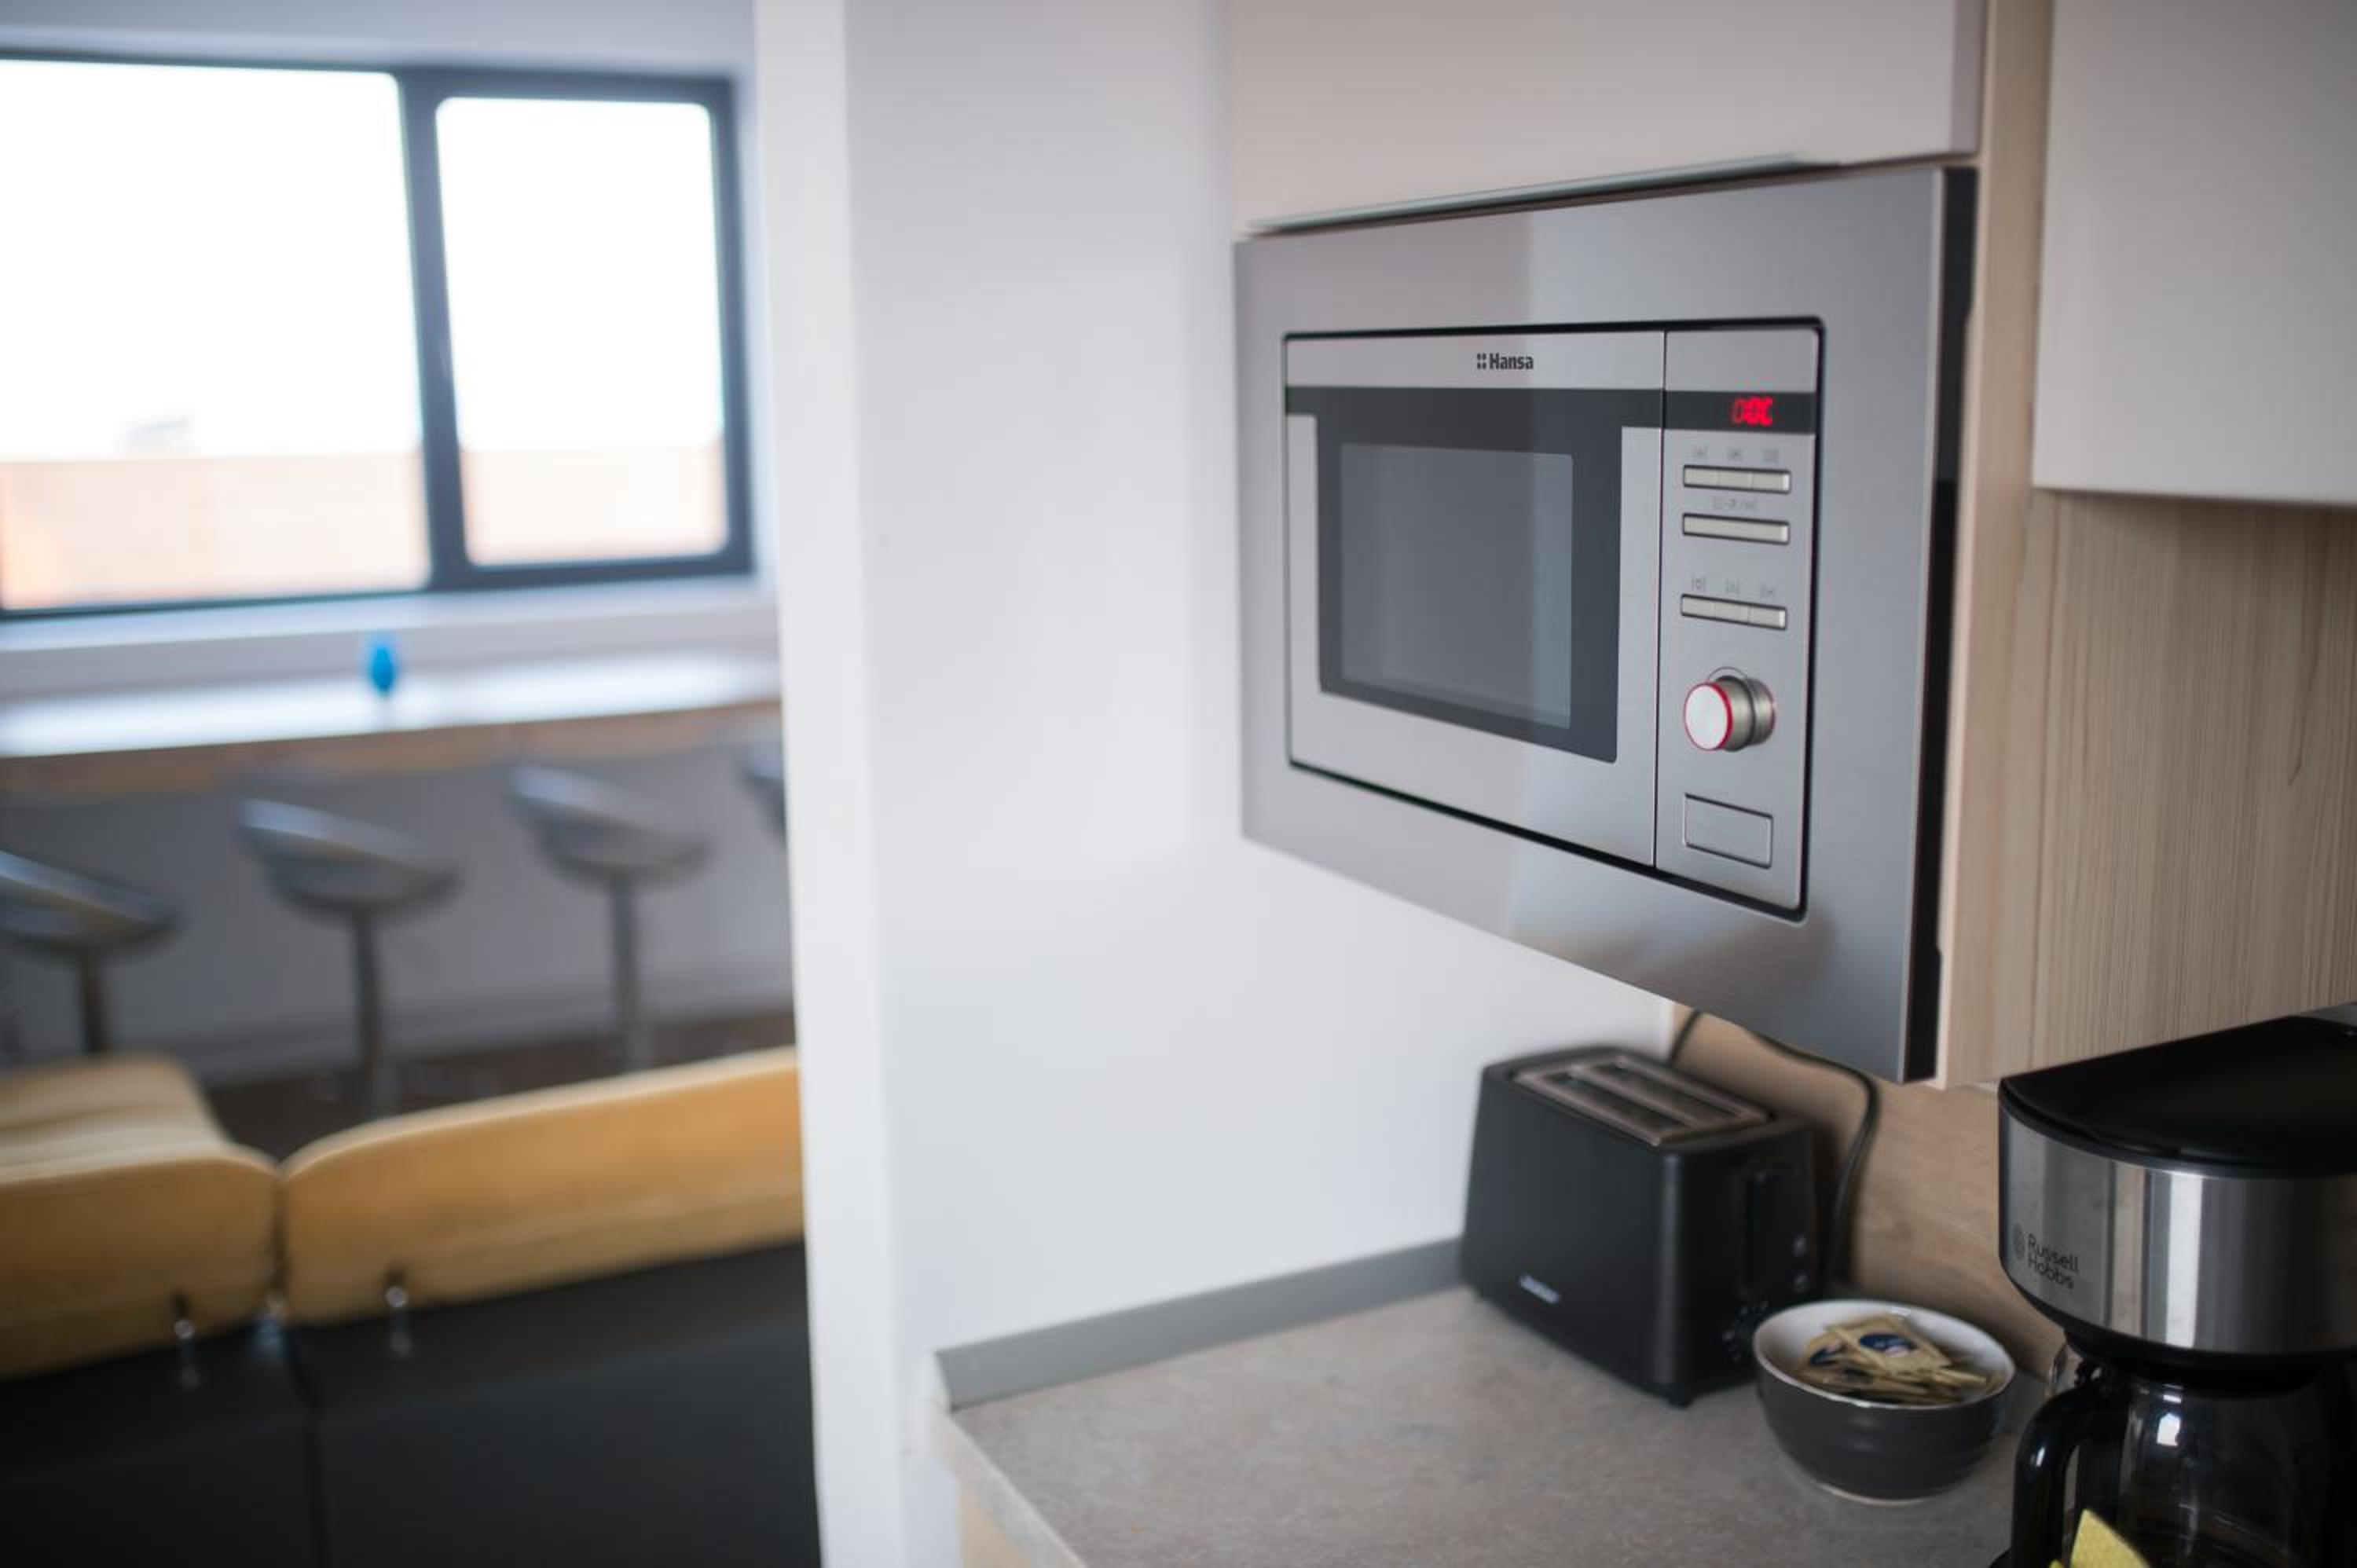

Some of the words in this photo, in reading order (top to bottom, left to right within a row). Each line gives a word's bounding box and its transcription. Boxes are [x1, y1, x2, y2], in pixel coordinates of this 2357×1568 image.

[1489, 352, 1534, 370] Hansa
[2027, 1233, 2079, 1273] Russell
[2027, 1252, 2075, 1289] Hobbs
